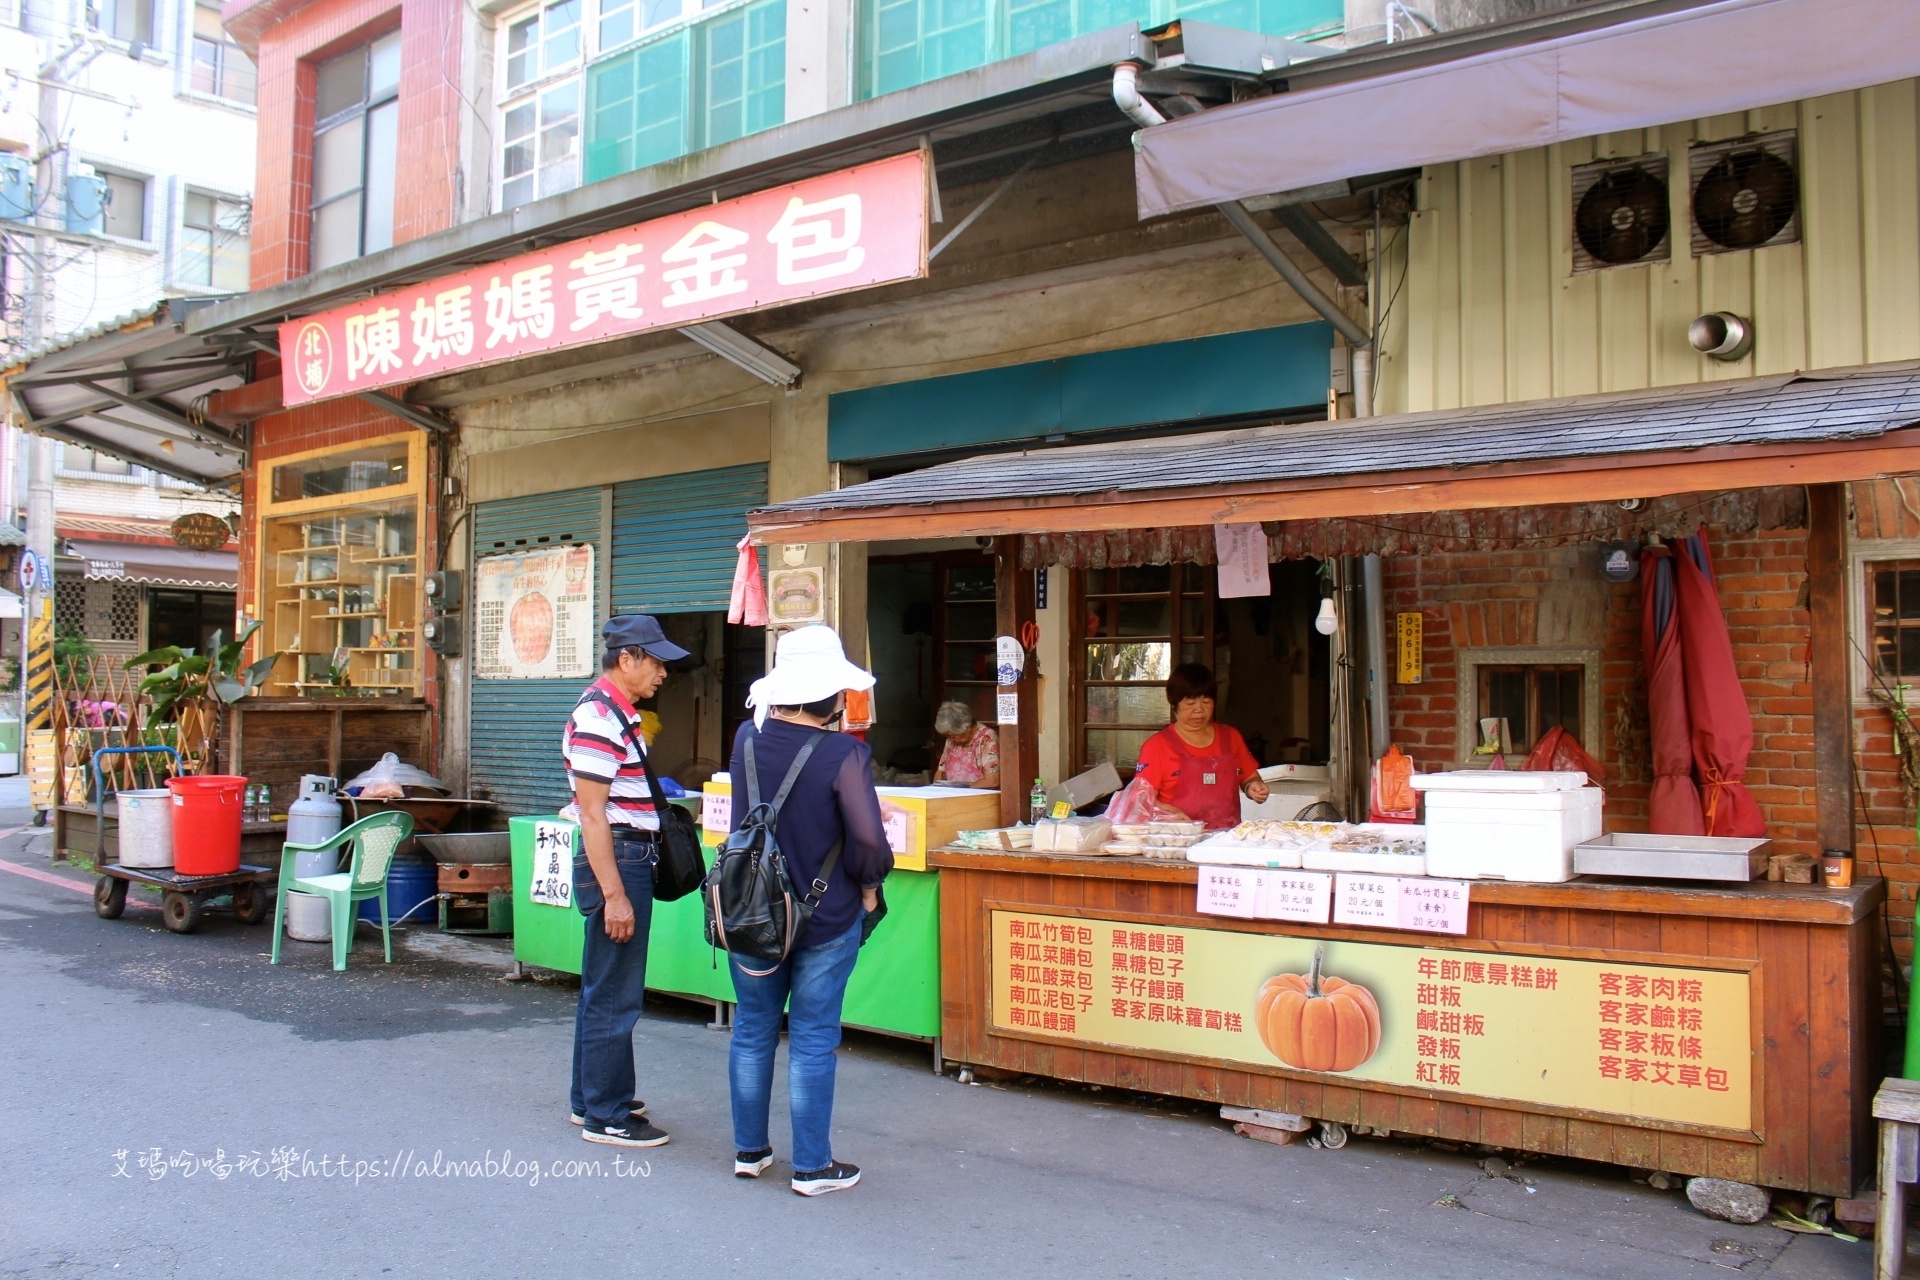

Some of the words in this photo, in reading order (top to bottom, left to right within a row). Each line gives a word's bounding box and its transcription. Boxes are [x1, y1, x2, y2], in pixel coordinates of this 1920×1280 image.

[344, 193, 865, 381] 陳媽媽黃金包
[304, 327, 324, 389] 北埔
[1405, 617, 1413, 671] 00619
[1209, 889, 1218, 897] 30
[1220, 891, 1239, 900] 元/個
[1210, 876, 1241, 887] 客家菜包
[1281, 880, 1315, 892] 客家菜包
[1349, 882, 1385, 894] 艾草菜包
[1403, 886, 1461, 900] 南瓜竹筍菜包
[1280, 894, 1289, 903] 30
[1291, 895, 1313, 905] 元/個
[1348, 897, 1358, 906] 20
[1360, 898, 1383, 908] 元/個
[1417, 902, 1446, 914] (素食)
[1010, 920, 1093, 945] 南瓜竹筍包
[1413, 917, 1423, 927] 20
[1426, 919, 1449, 929] 元/個
[1010, 942, 1093, 968] 南瓜菜脯包
[1111, 929, 1184, 955] 黑糖饅頭
[1010, 963, 1093, 990] 南瓜酸菜包
[1111, 952, 1184, 978] 黑糖包子
[1417, 957, 1558, 990] 年節應景糕餅
[1010, 985, 1093, 1013] 南瓜泥包子
[1111, 975, 1184, 1002] 芋仔饅頭
[1417, 983, 1462, 1008] 甜粄
[1599, 972, 1703, 1003] 客家肉粽
[1010, 1007, 1076, 1033] 南瓜饅頭
[1111, 998, 1242, 1033] 客家原味蘿蔔糕
[1416, 1009, 1485, 1037] 鹹甜粄
[1599, 1000, 1703, 1032] 客家鹼粽
[1417, 1034, 1461, 1060] 發粄
[1599, 1028, 1702, 1060] 客家粄條
[1416, 1060, 1461, 1086] 紅粄
[1599, 1055, 1729, 1092] 客家艾草包
